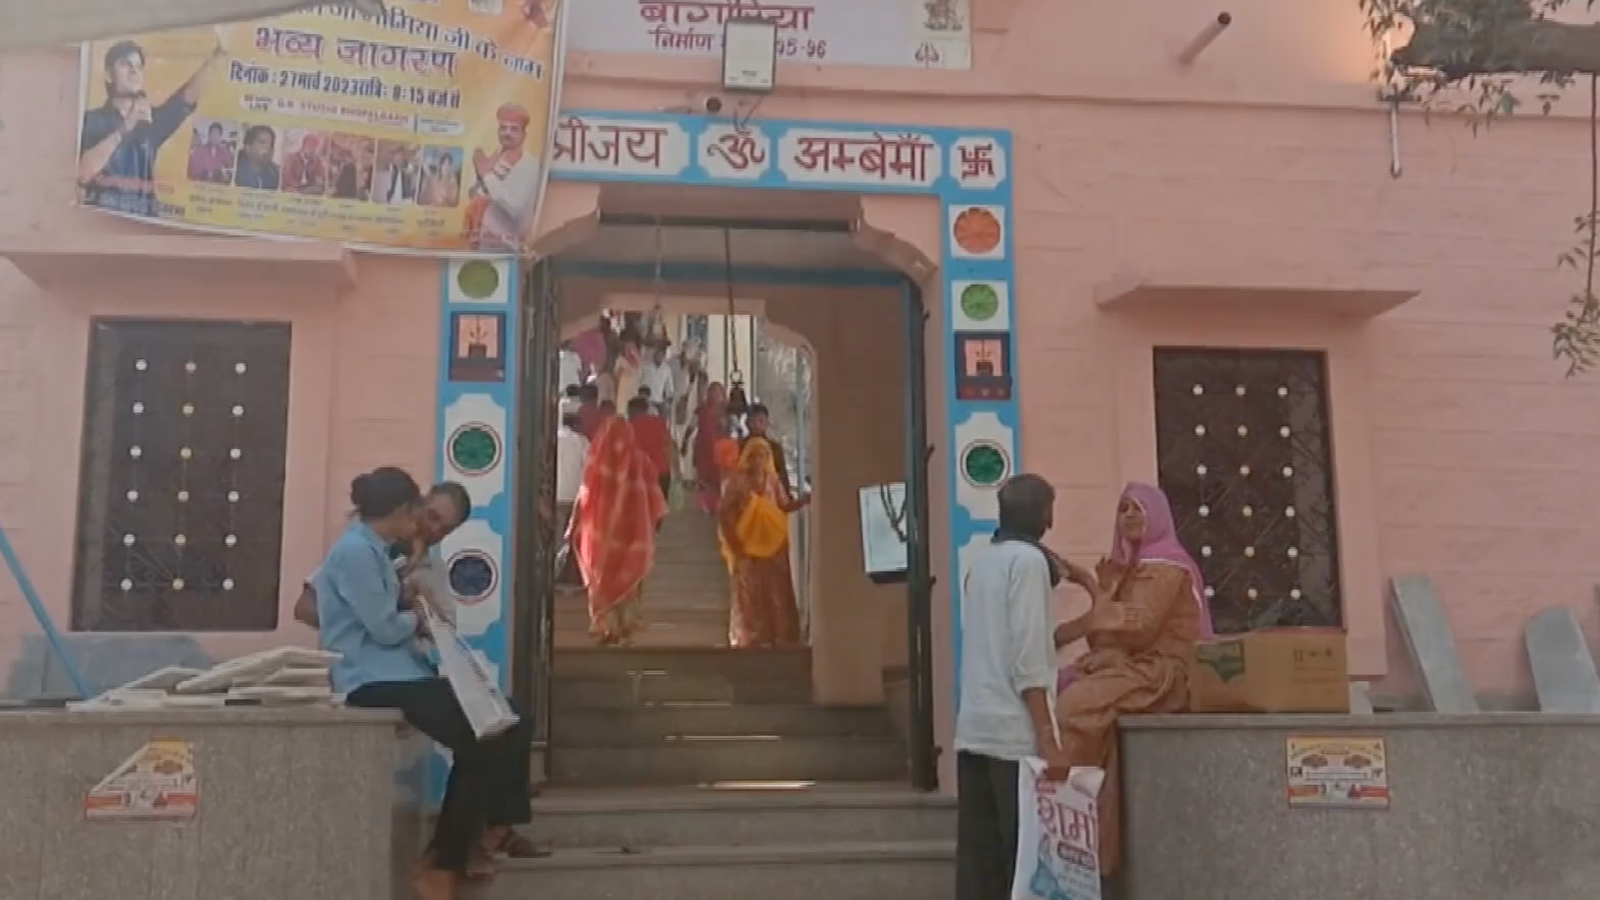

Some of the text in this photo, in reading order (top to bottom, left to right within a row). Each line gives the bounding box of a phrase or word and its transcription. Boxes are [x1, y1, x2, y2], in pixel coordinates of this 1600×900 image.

[255, 26, 458, 77] भव्य जागरण
[648, 24, 715, 51] निर्माण
